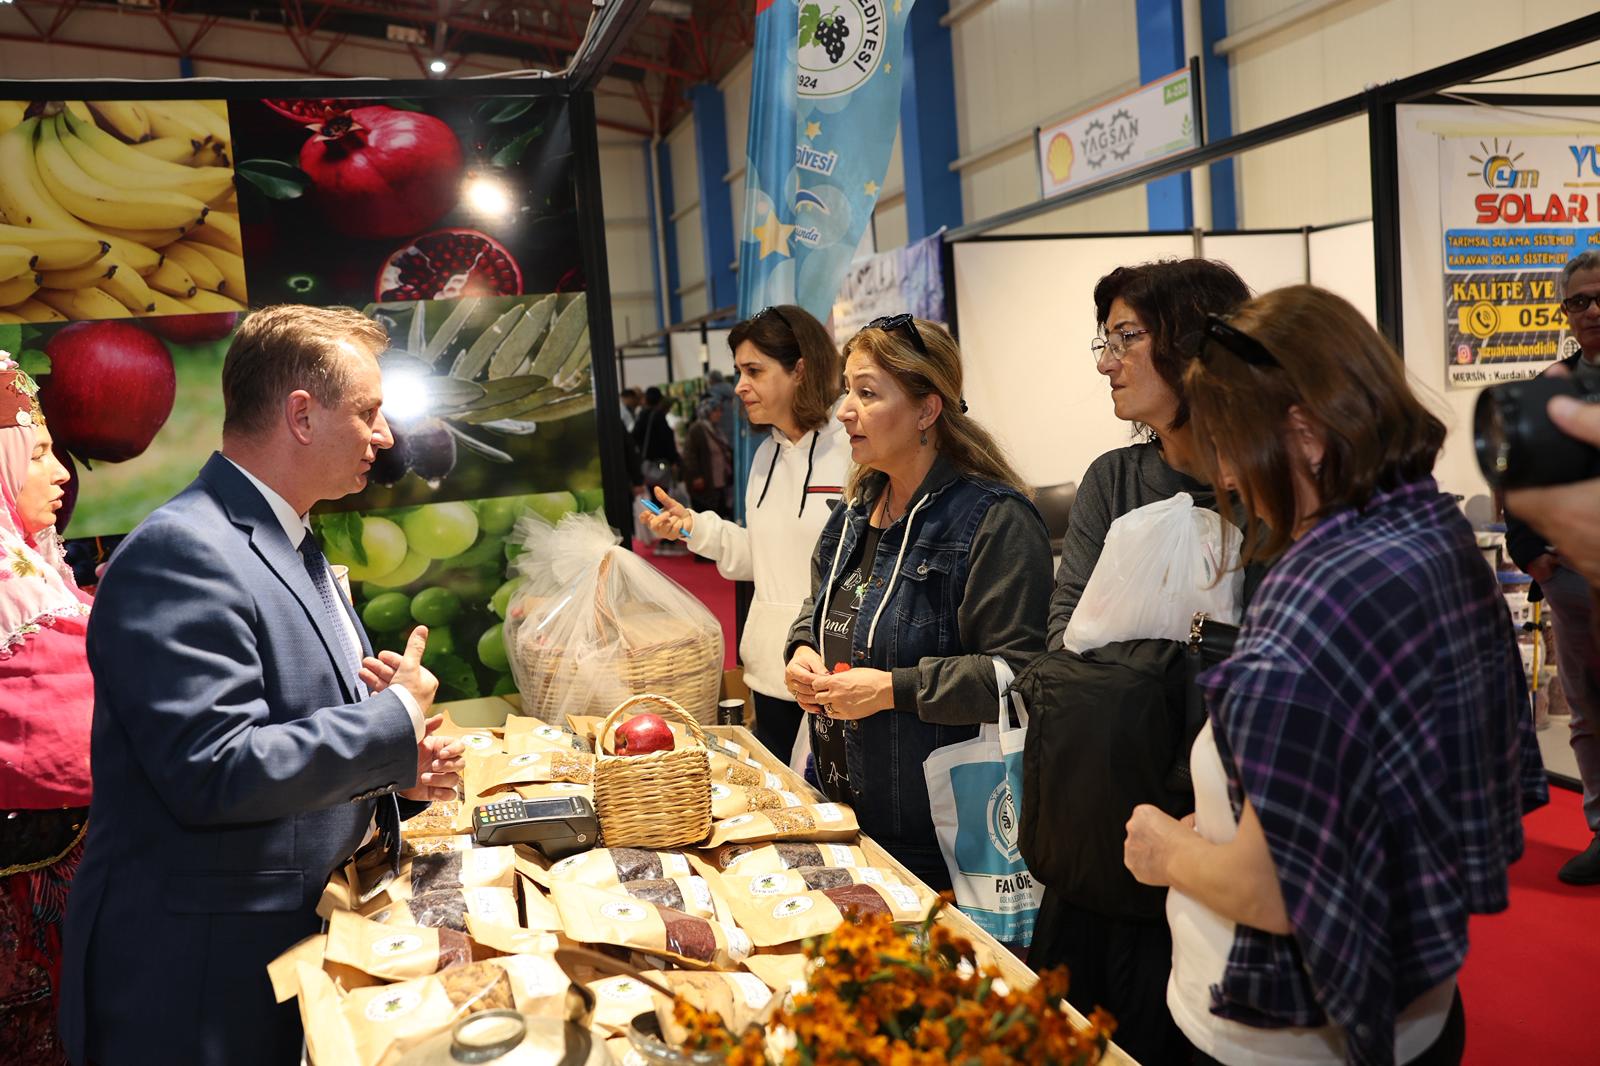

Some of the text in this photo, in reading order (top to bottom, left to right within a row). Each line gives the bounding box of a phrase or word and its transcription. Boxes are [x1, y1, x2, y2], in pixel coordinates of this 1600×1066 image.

[1475, 193, 1589, 224] SOLAR
[1491, 254, 1521, 265] SOLAR
[1452, 277, 1555, 301] KALİTE VE
[1519, 308, 1568, 328] 054
[1452, 370, 1487, 381] MERSİN
